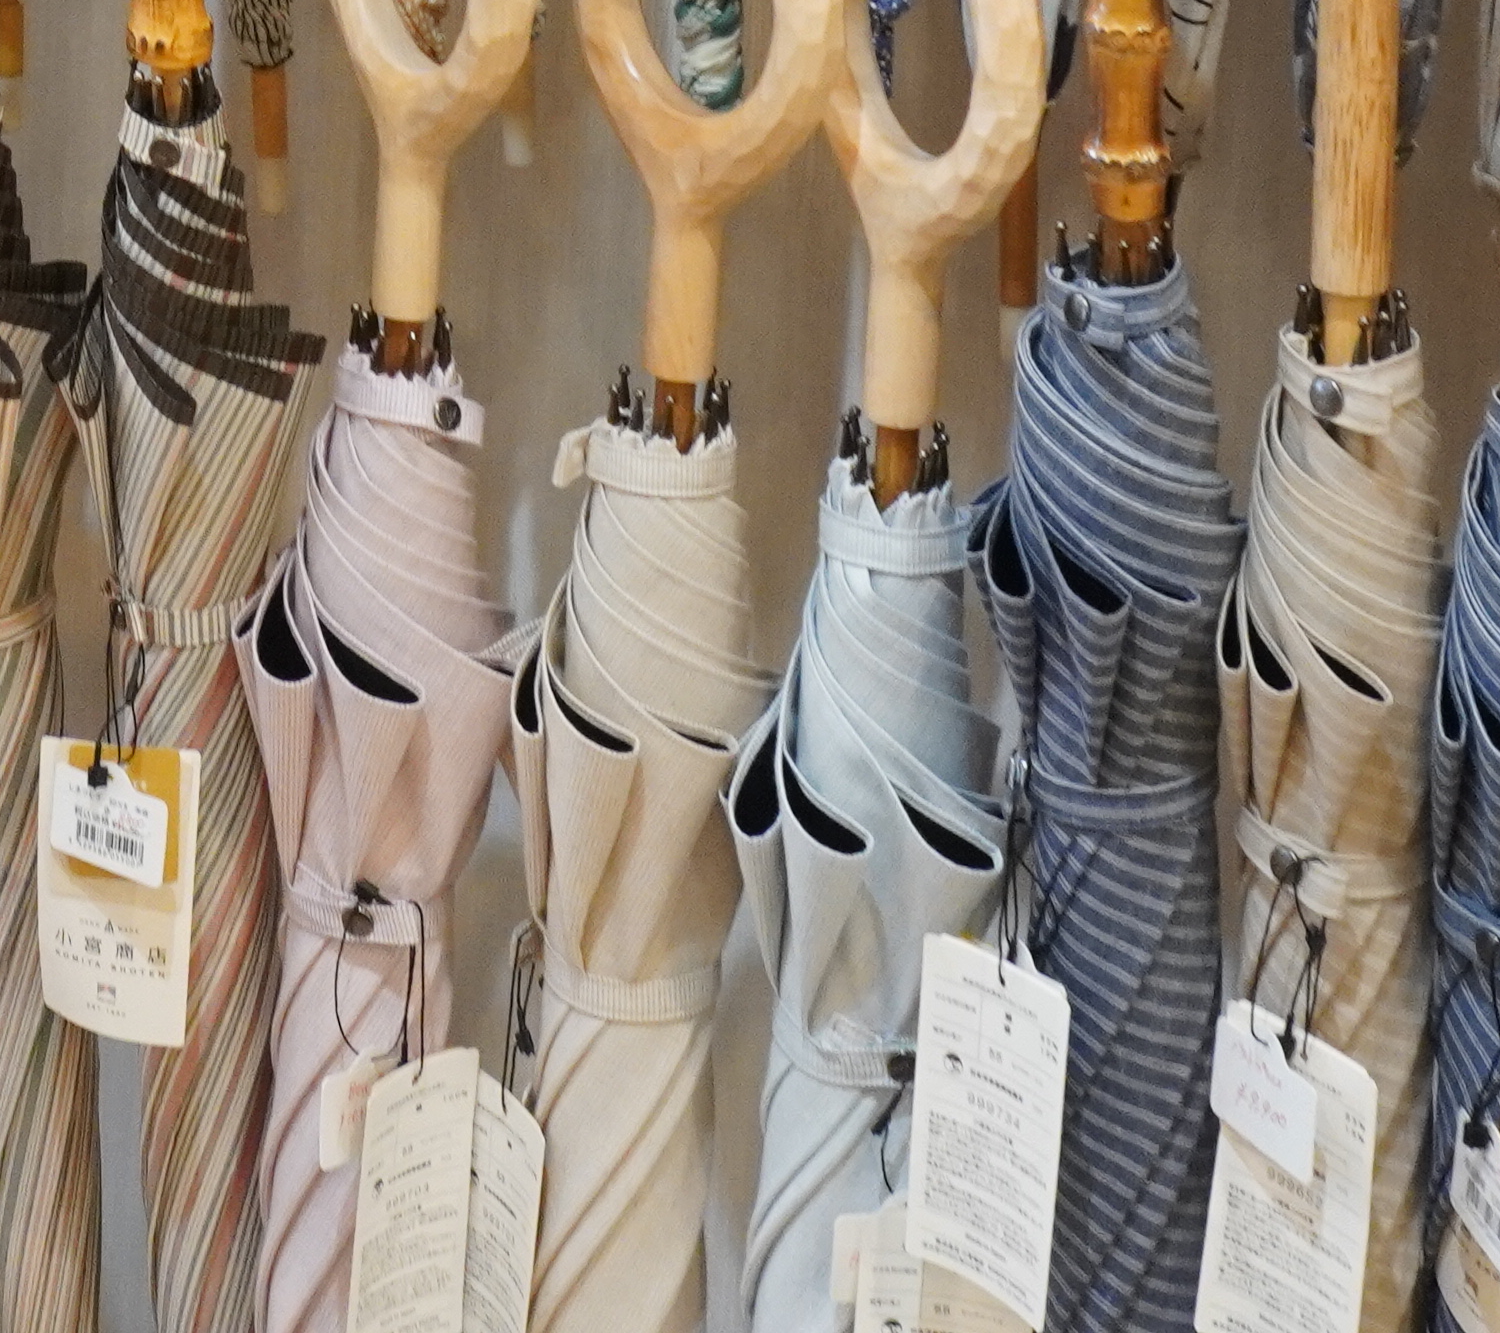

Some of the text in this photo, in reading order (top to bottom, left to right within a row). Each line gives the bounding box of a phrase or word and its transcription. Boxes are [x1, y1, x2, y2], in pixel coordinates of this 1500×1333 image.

[55, 928, 167, 965] 小宮商店
[55, 949, 167, 980] KOMIYA SHOTEN
